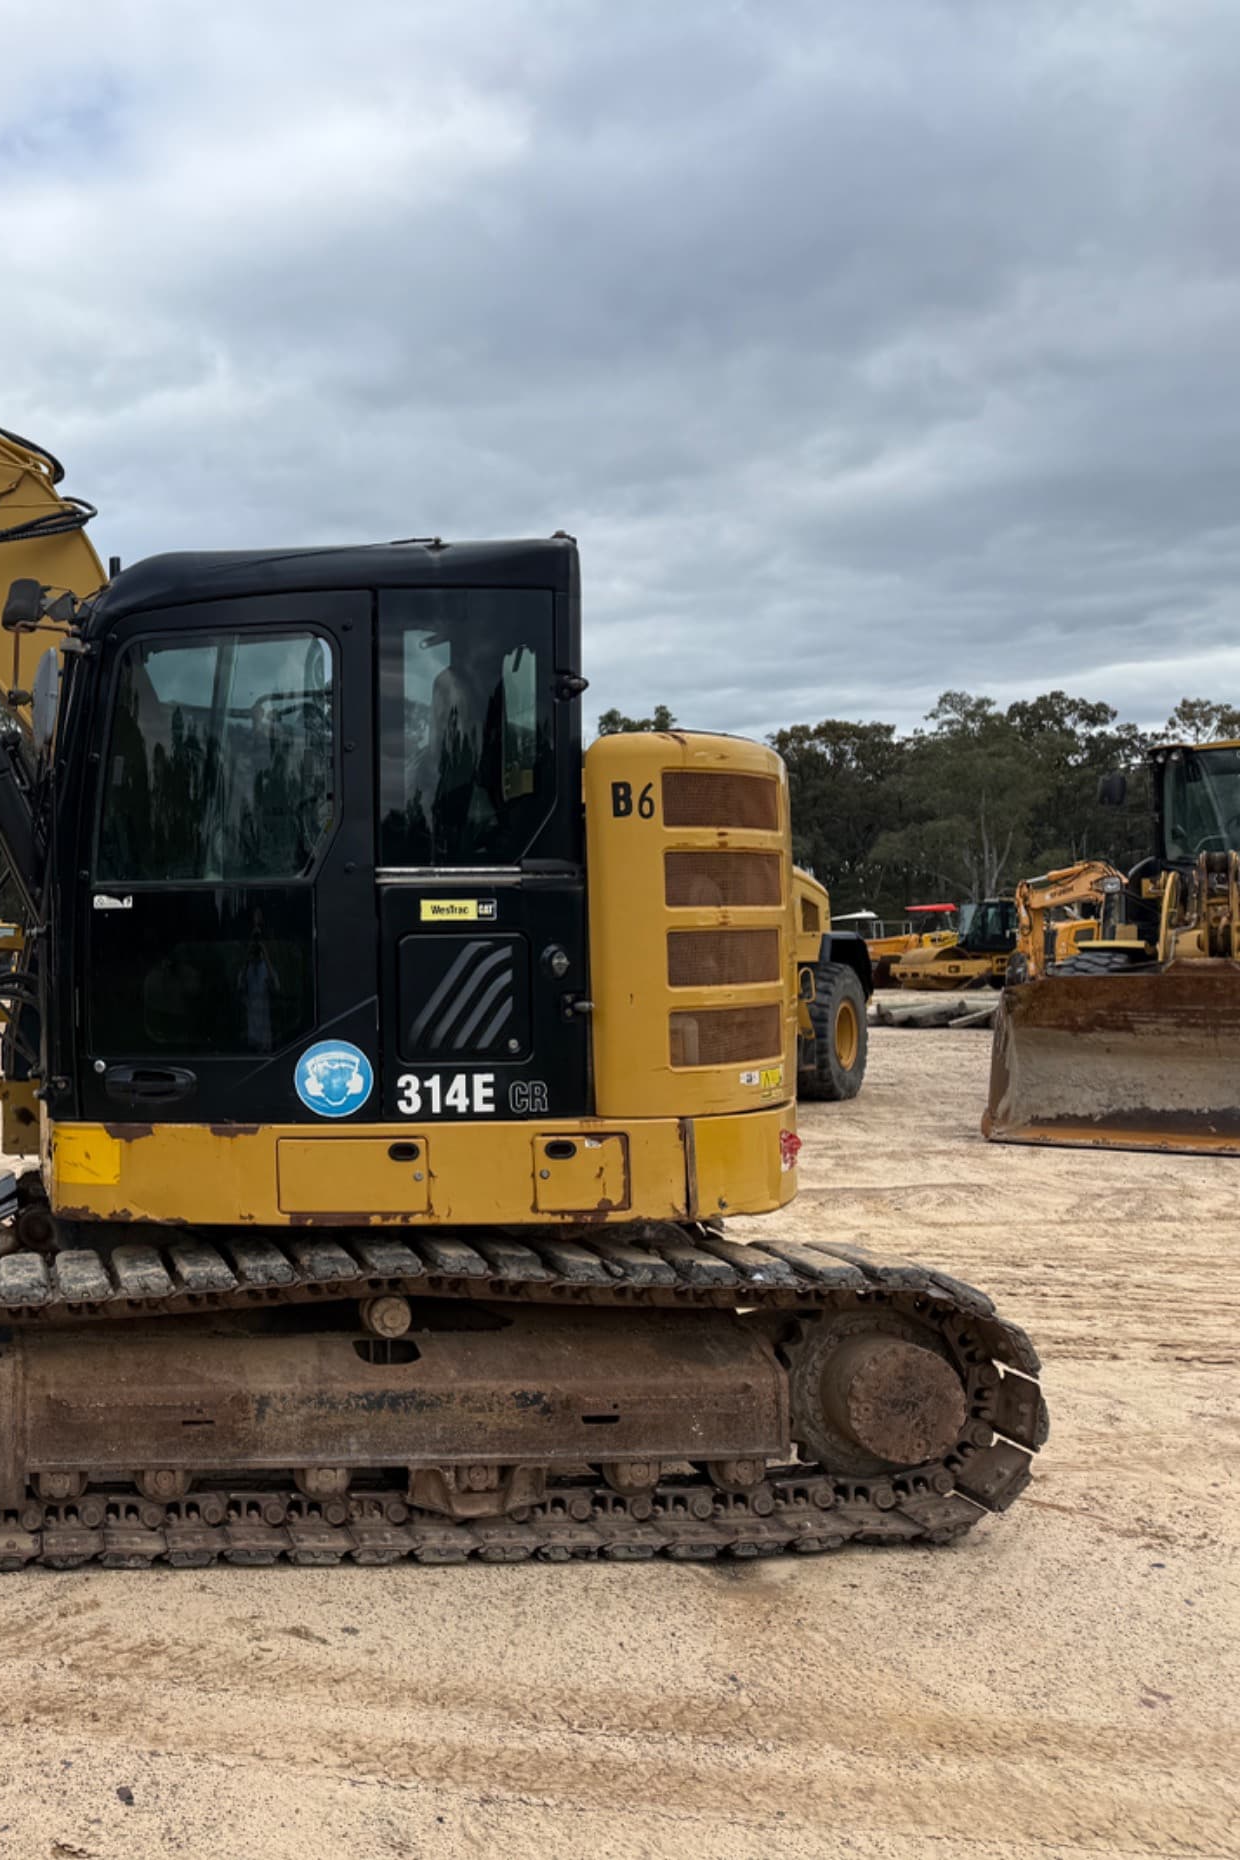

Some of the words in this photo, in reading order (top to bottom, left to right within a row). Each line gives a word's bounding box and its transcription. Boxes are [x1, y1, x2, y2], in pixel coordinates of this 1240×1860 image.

[611, 781, 655, 819] B6
[431, 904, 469, 914] WesTrac
[478, 903, 492, 914] CAT
[396, 1074, 495, 1114] 314E
[508, 1080, 549, 1113] CR
